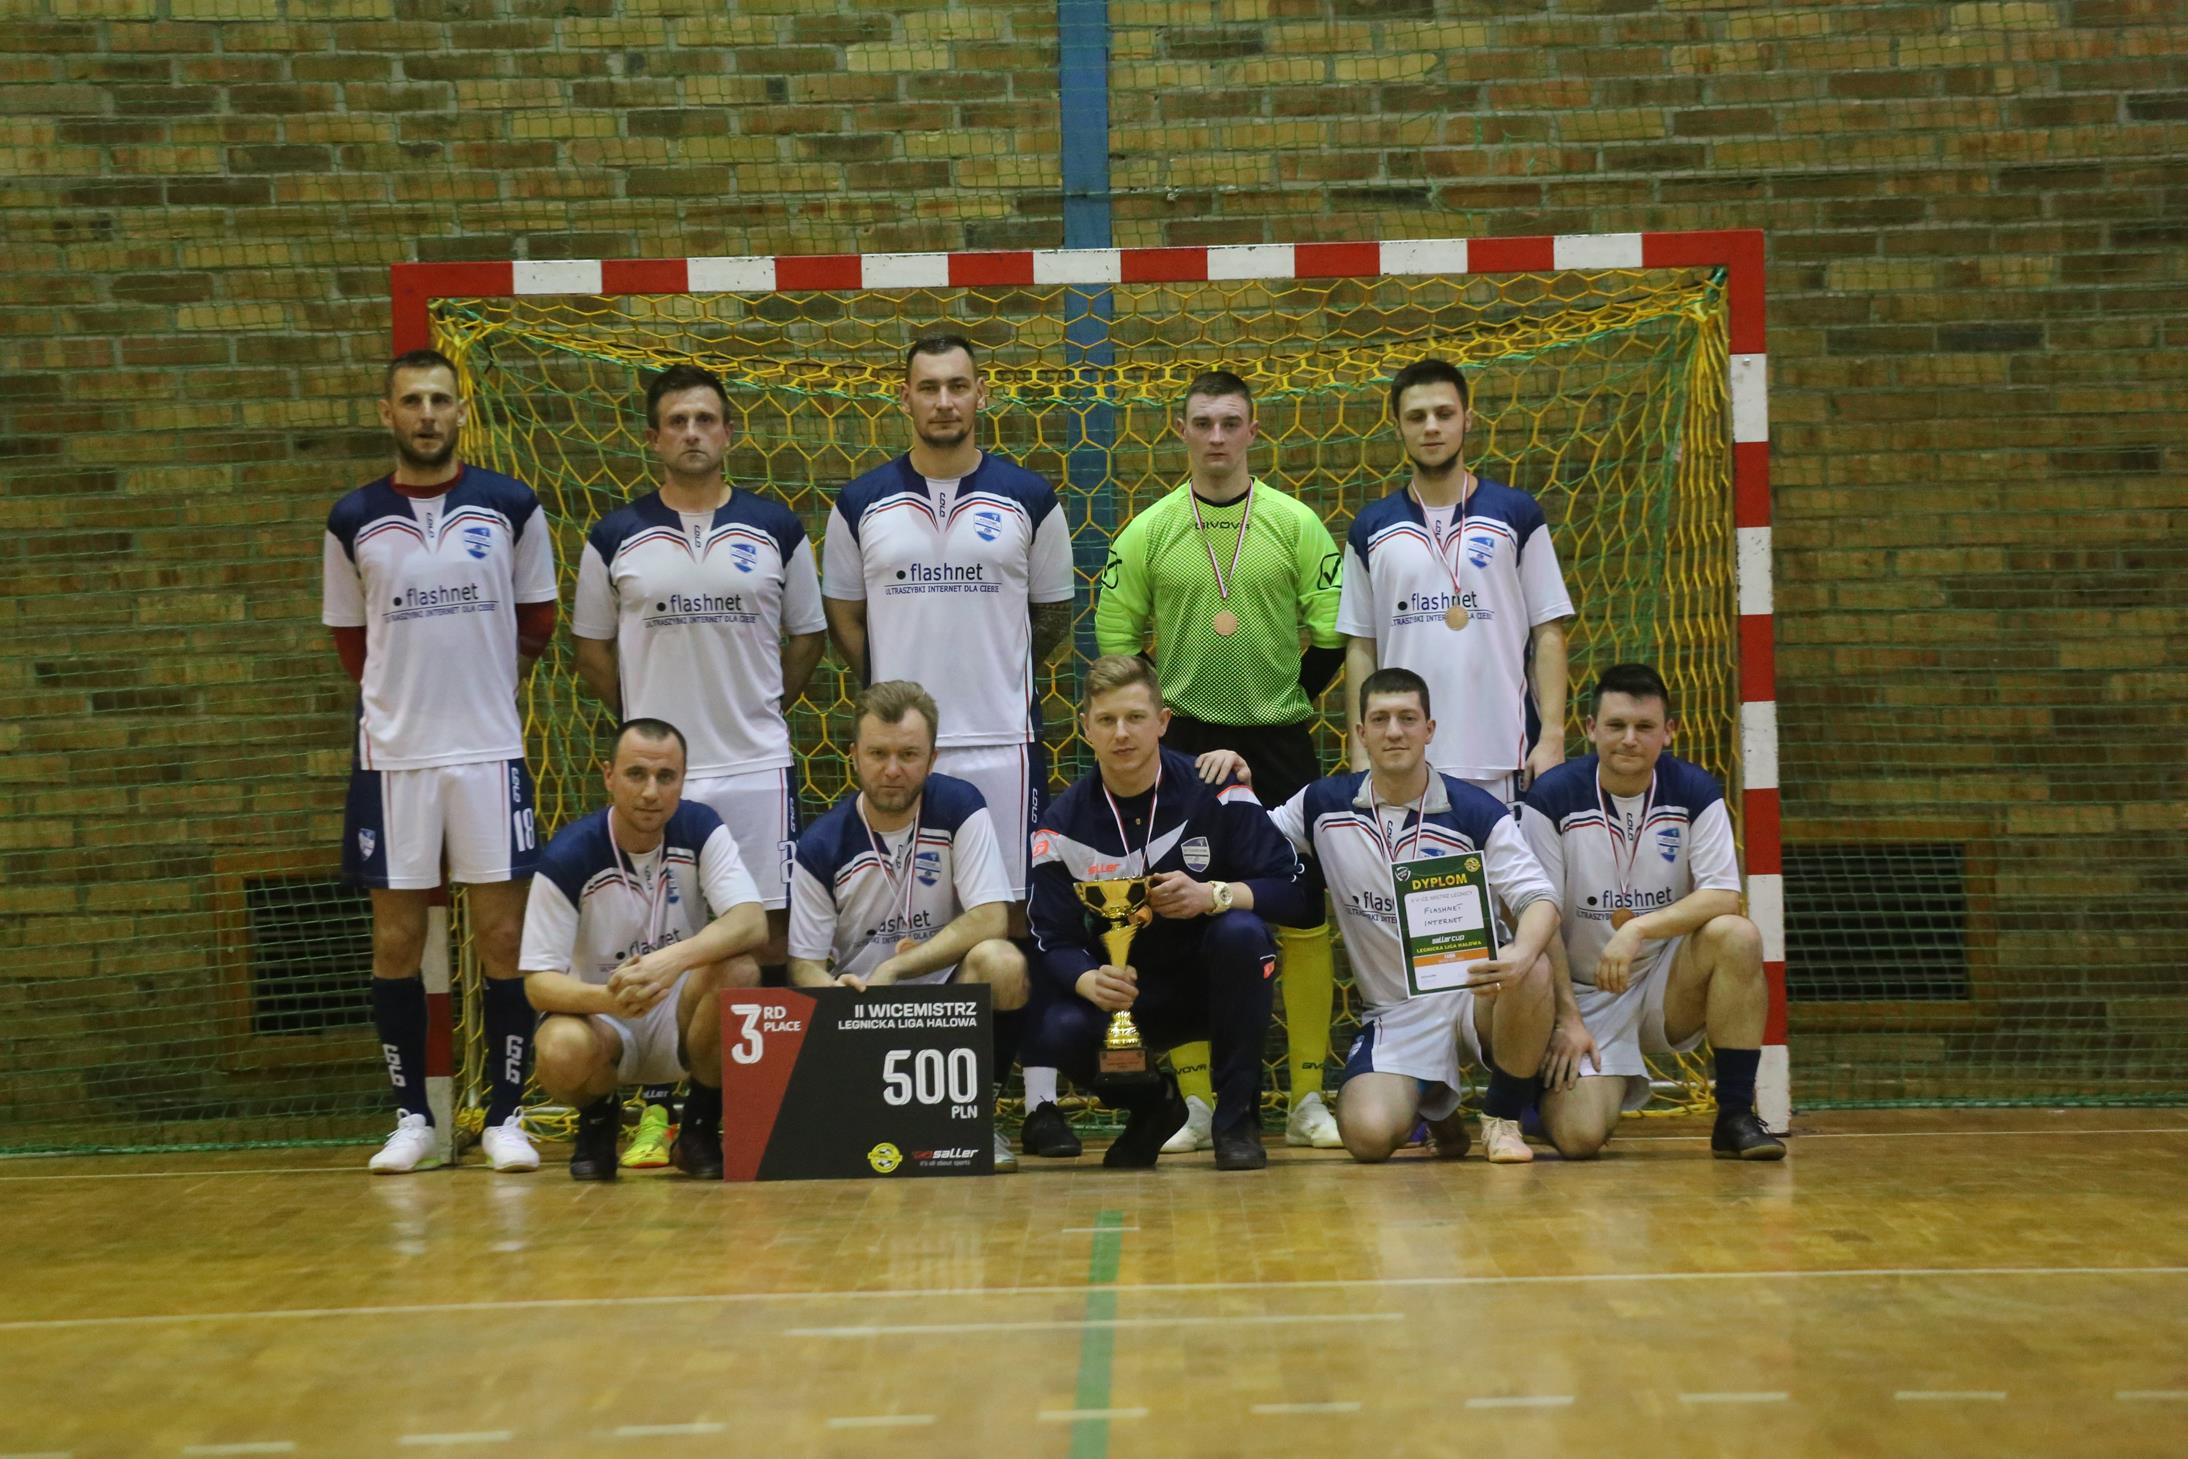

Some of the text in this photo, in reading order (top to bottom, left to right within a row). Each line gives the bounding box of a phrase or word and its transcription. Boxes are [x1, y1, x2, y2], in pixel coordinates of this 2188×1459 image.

[910, 562, 983, 582] flashnet
[406, 583, 479, 607] flashnet
[928, 584, 962, 594] INTERNET
[964, 584, 978, 593] DLA
[670, 593, 742, 613] flashnet
[513, 807, 536, 853] 18
[1412, 873, 1468, 891] DYPLOM
[1602, 886, 1673, 909] flashnet
[855, 1001, 977, 1019] II WICEMISTRZ
[763, 1020, 802, 1032] PLACE
[838, 1017, 978, 1030] LEGNICKA LIGA HALOWA
[730, 1004, 787, 1065] 3 RD
[882, 1047, 978, 1106] 500
[951, 1105, 978, 1120] PLN
[932, 1148, 979, 1159] saller
